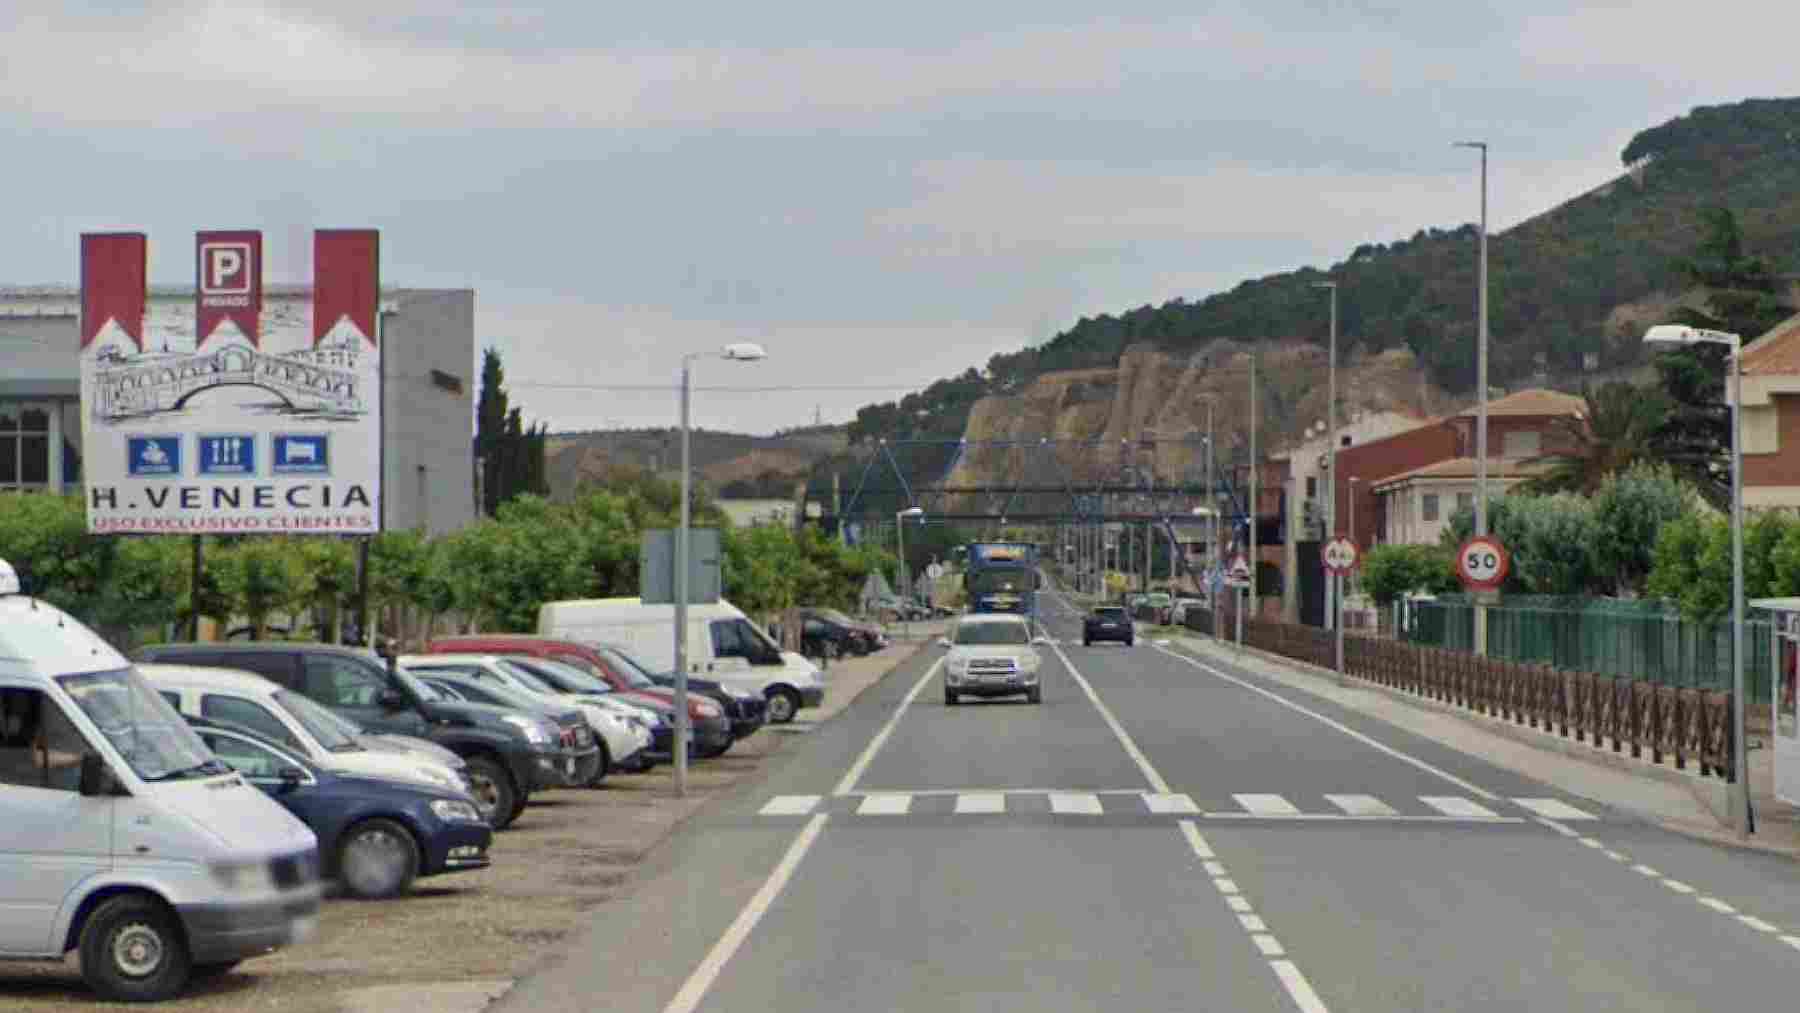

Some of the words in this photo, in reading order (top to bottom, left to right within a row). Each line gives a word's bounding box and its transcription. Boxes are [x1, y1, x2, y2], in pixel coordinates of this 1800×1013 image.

[213, 249, 241, 287] P
[95, 516, 136, 531] USO
[141, 516, 260, 530] EXCLUSIVO
[266, 515, 372, 529] CLIENTES
[1467, 552, 1497, 569] 50
